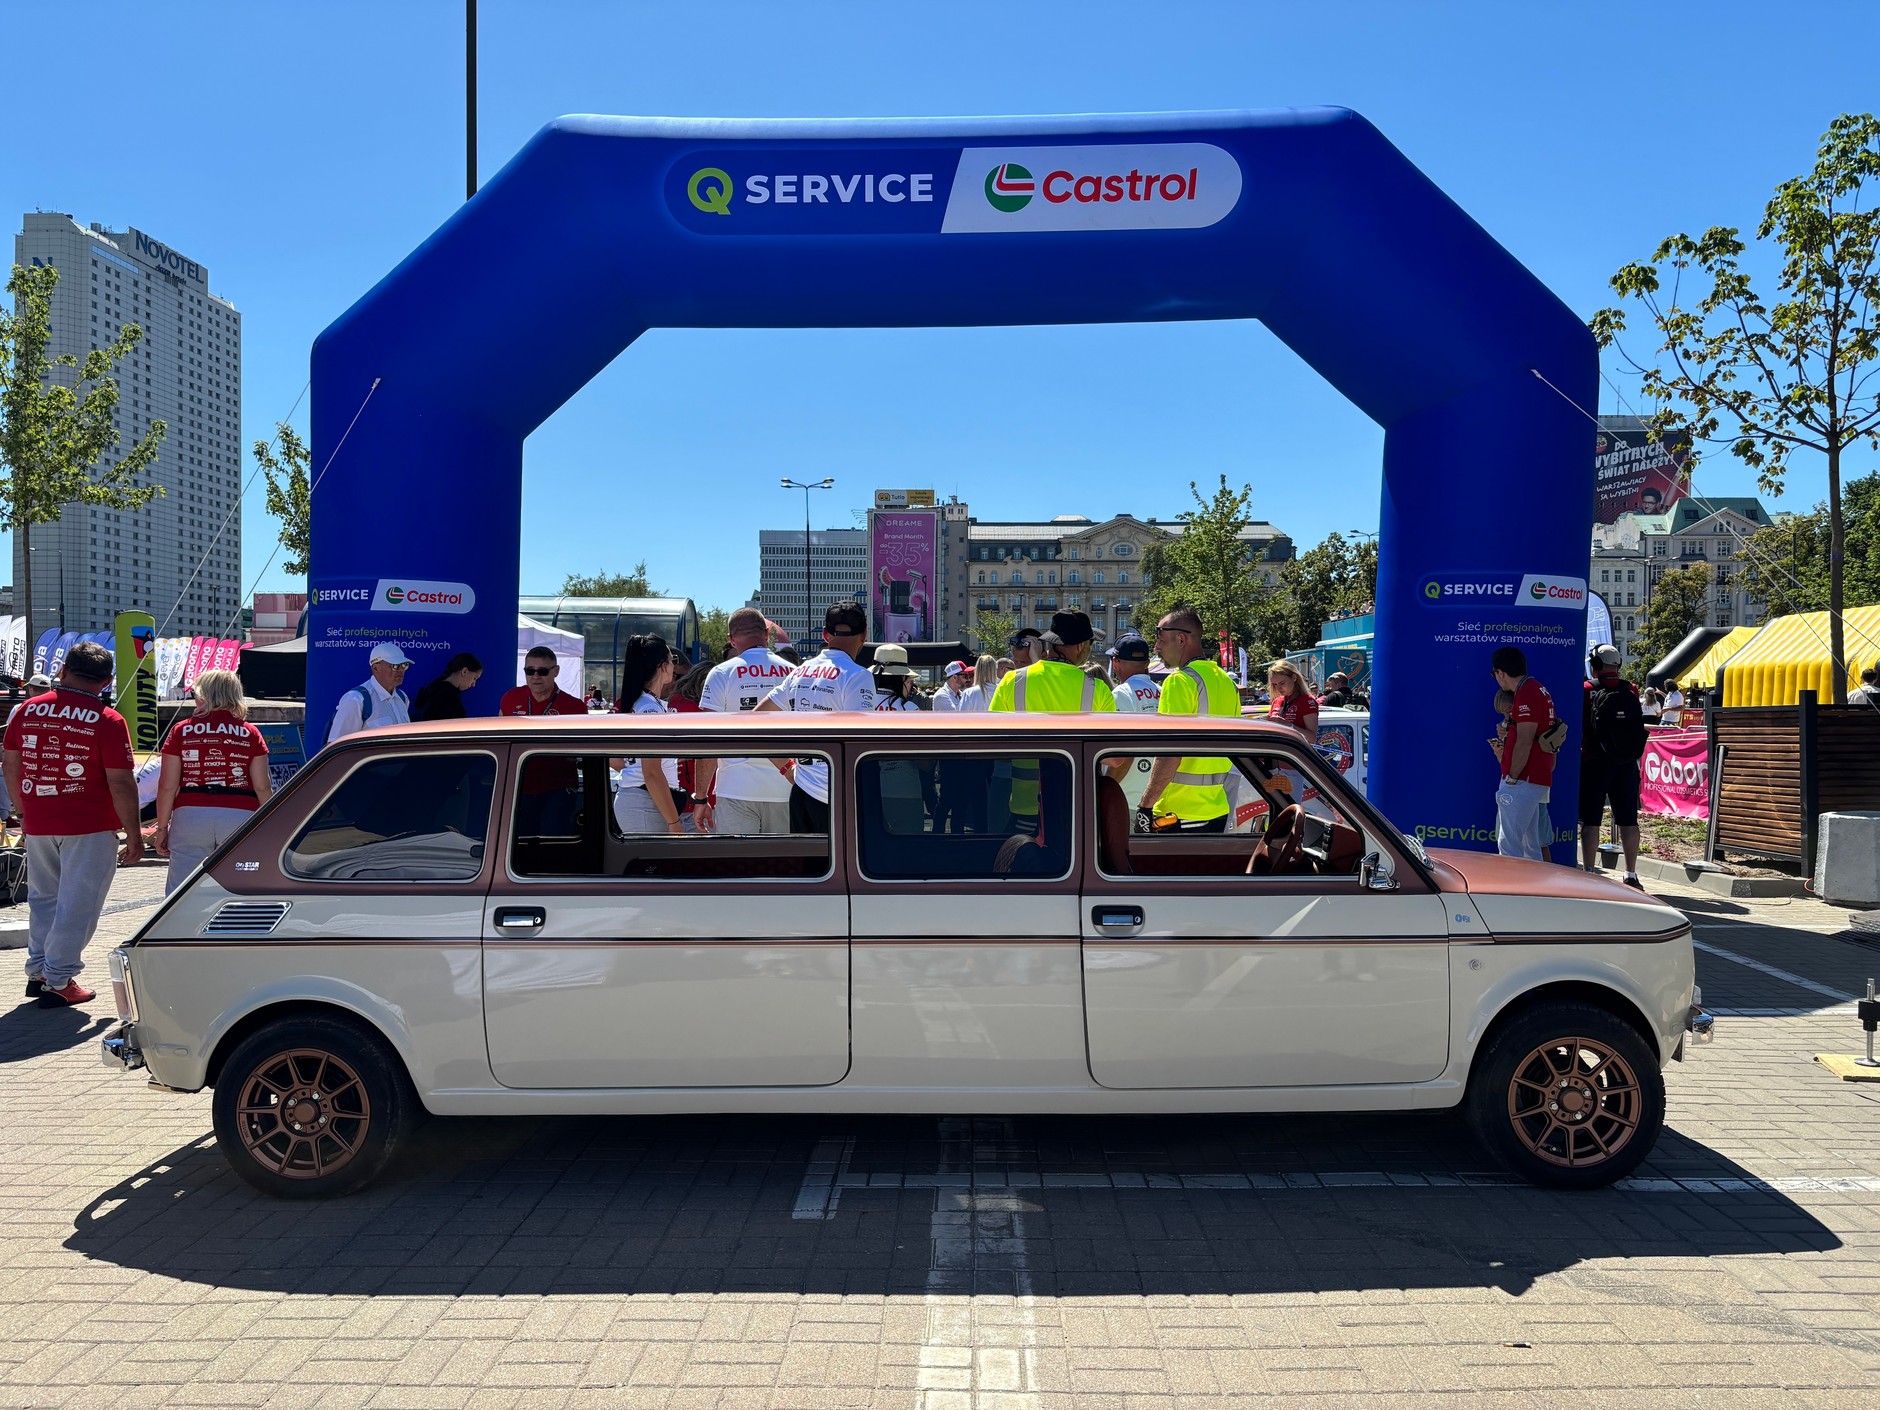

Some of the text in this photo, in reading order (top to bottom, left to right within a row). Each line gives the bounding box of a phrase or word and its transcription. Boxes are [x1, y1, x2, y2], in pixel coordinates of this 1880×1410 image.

[745, 173, 934, 204] SERVICE
[1042, 167, 1198, 204] Castrol
[135, 230, 204, 285] NOVOTEL
[1614, 440, 1628, 451] DO
[1597, 464, 1631, 480] ŚWIAT
[1596, 476, 1647, 492] WARSZAWIACY
[1609, 487, 1639, 498] WYBITNI
[319, 589, 369, 601] SERVICE
[406, 590, 462, 605] Castrol
[1444, 583, 1514, 596] SERVICE
[1548, 585, 1583, 601] Castrol
[326, 627, 428, 639] Sieć profesjonalnych
[1457, 621, 1563, 635] Sieć profesjonalnych
[314, 638, 358, 648] warsztatów
[1434, 633, 1576, 647] warsztatów samochodowych
[184, 645, 198, 688] Gabona
[791, 665, 842, 681] POLAND
[24, 702, 100, 723] POLAND
[137, 668, 158, 753] KOLNITY
[182, 722, 251, 738] POLAND
